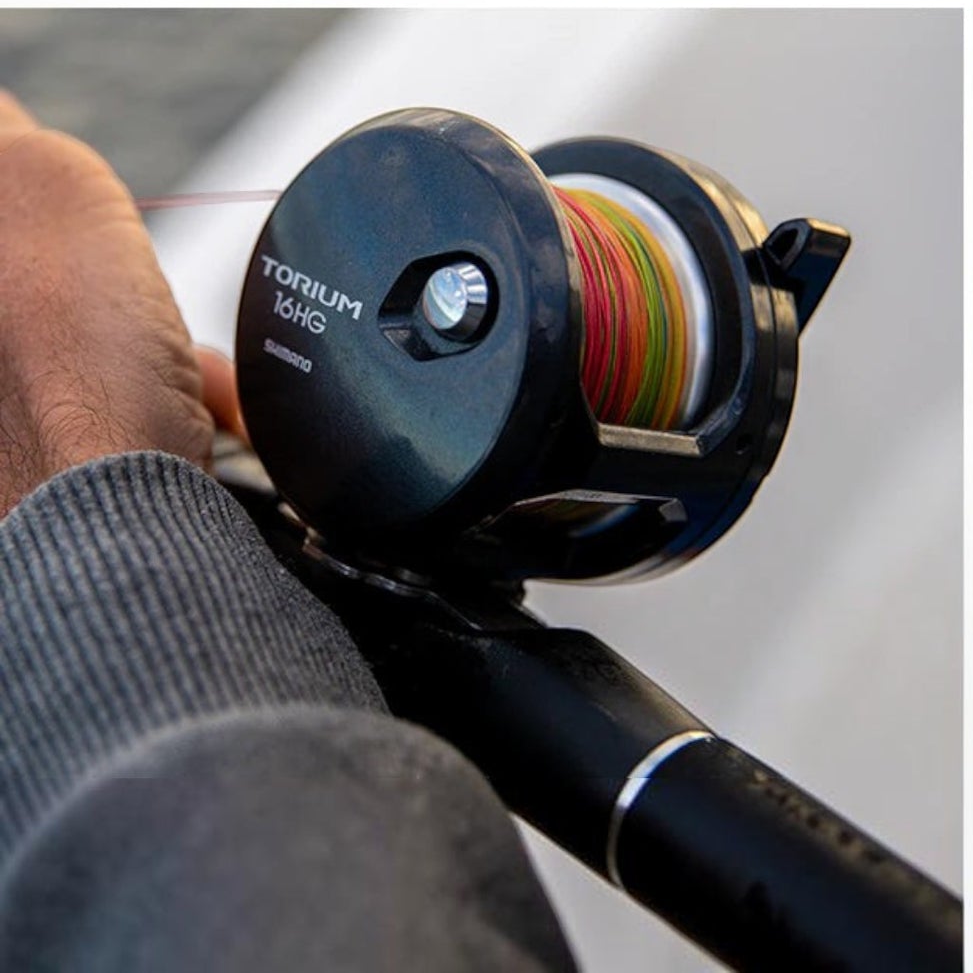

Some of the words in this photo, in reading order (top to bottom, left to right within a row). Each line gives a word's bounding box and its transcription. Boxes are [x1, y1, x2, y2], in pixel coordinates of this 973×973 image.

[261, 254, 364, 321] TORIUM
[273, 290, 327, 335] 16HG
[263, 338, 313, 374] SHIMANO
